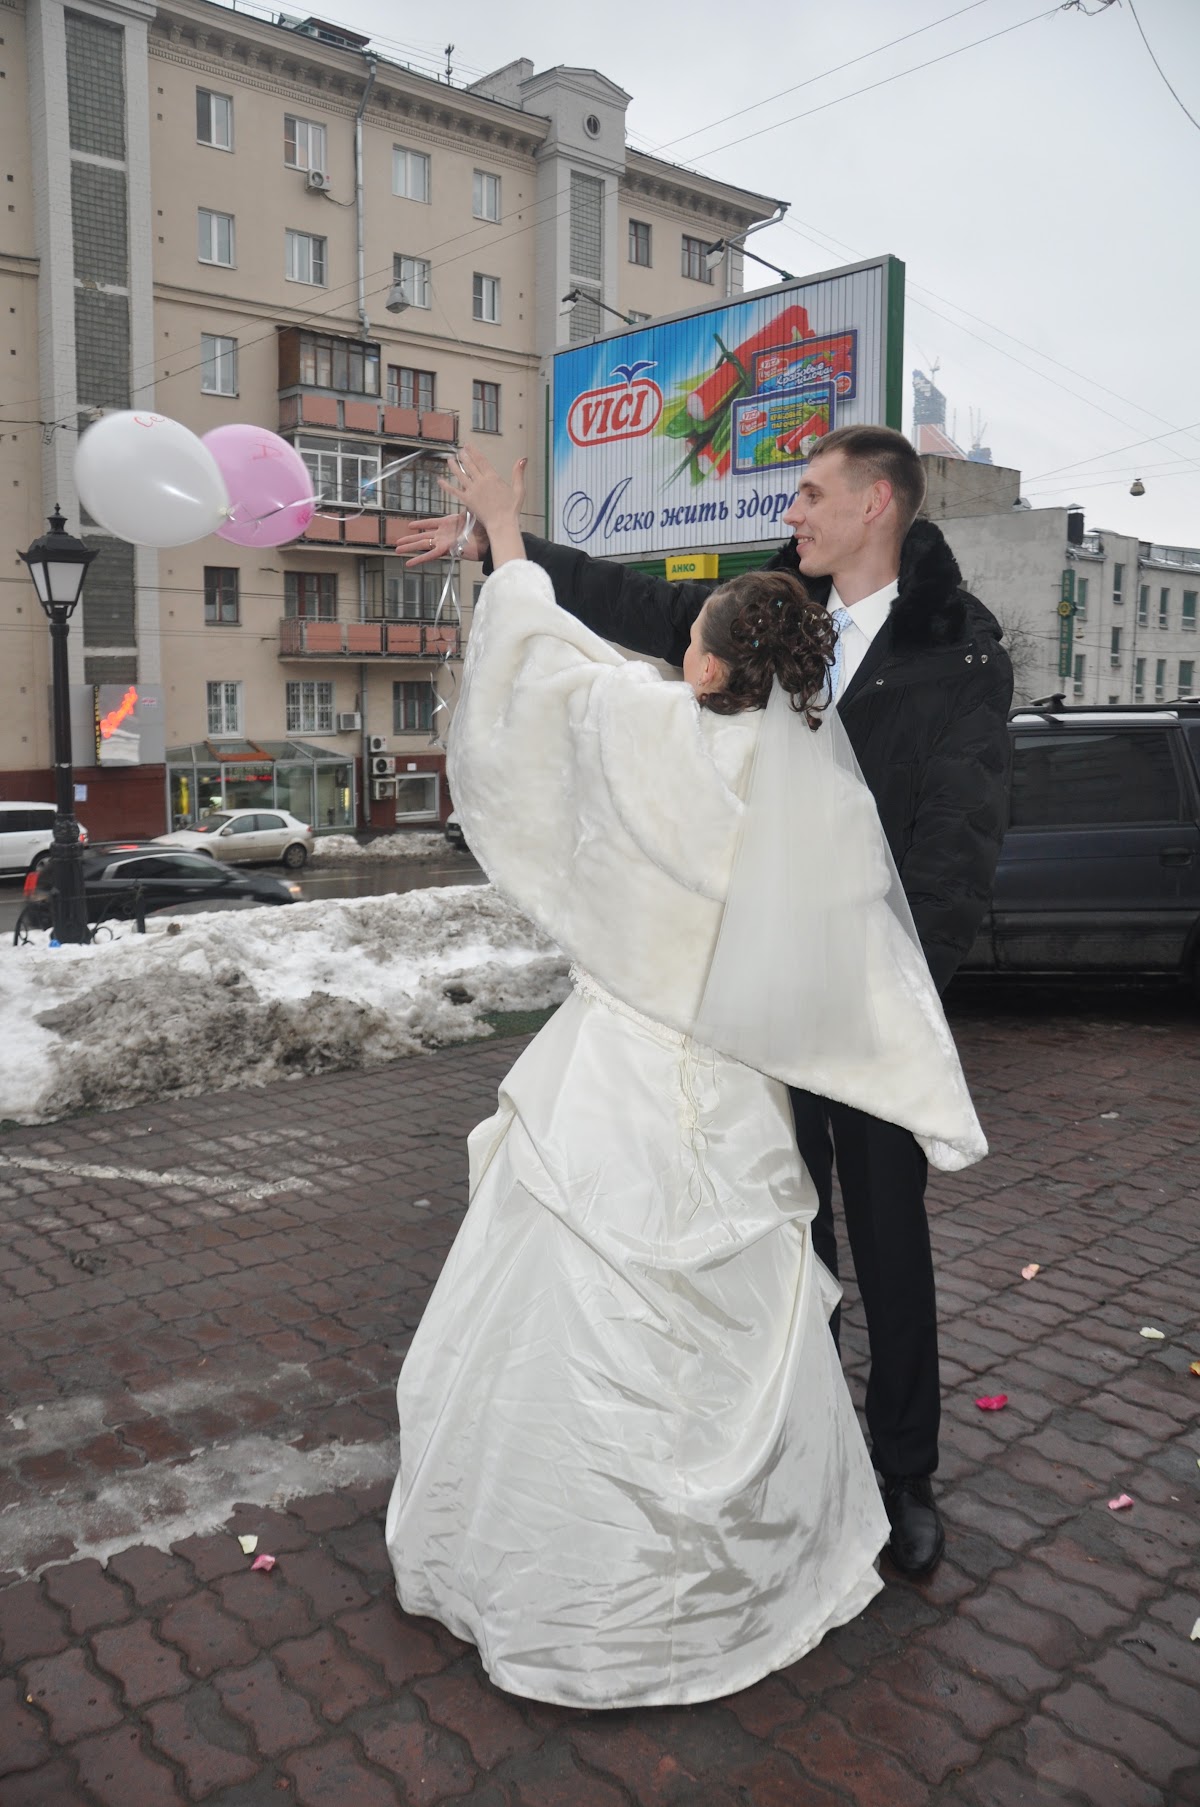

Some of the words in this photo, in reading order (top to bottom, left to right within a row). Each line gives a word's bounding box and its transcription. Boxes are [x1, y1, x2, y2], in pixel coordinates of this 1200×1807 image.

[582, 390, 649, 437] VICI
[562, 477, 655, 543] Легко
[660, 500, 729, 528] жить
[671, 563, 696, 573] АНКО
